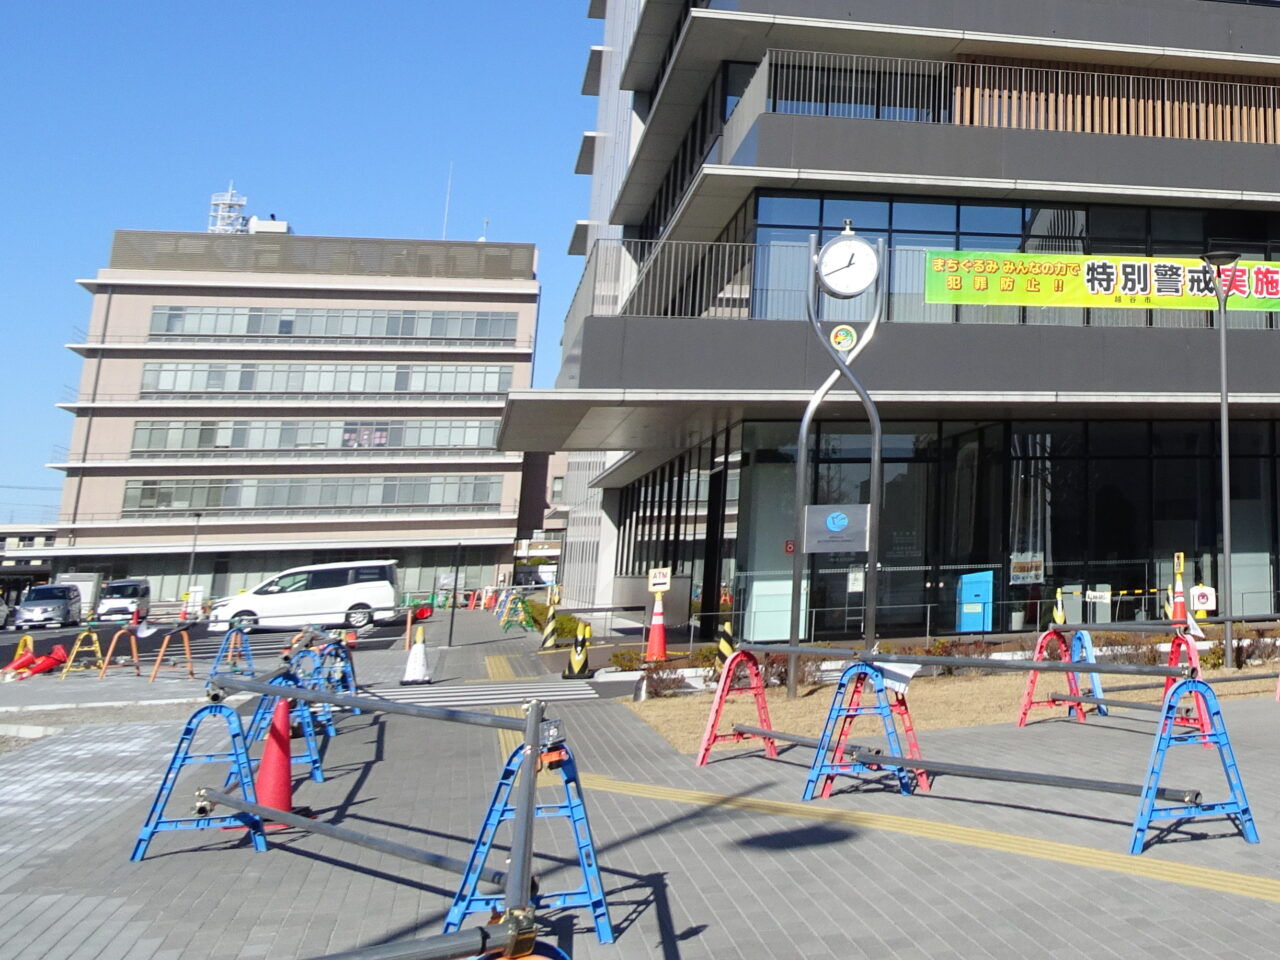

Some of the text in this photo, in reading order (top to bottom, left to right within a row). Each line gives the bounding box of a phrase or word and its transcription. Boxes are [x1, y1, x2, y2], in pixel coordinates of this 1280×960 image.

[932, 257, 1081, 275] まちぐるみ みんなの力で
